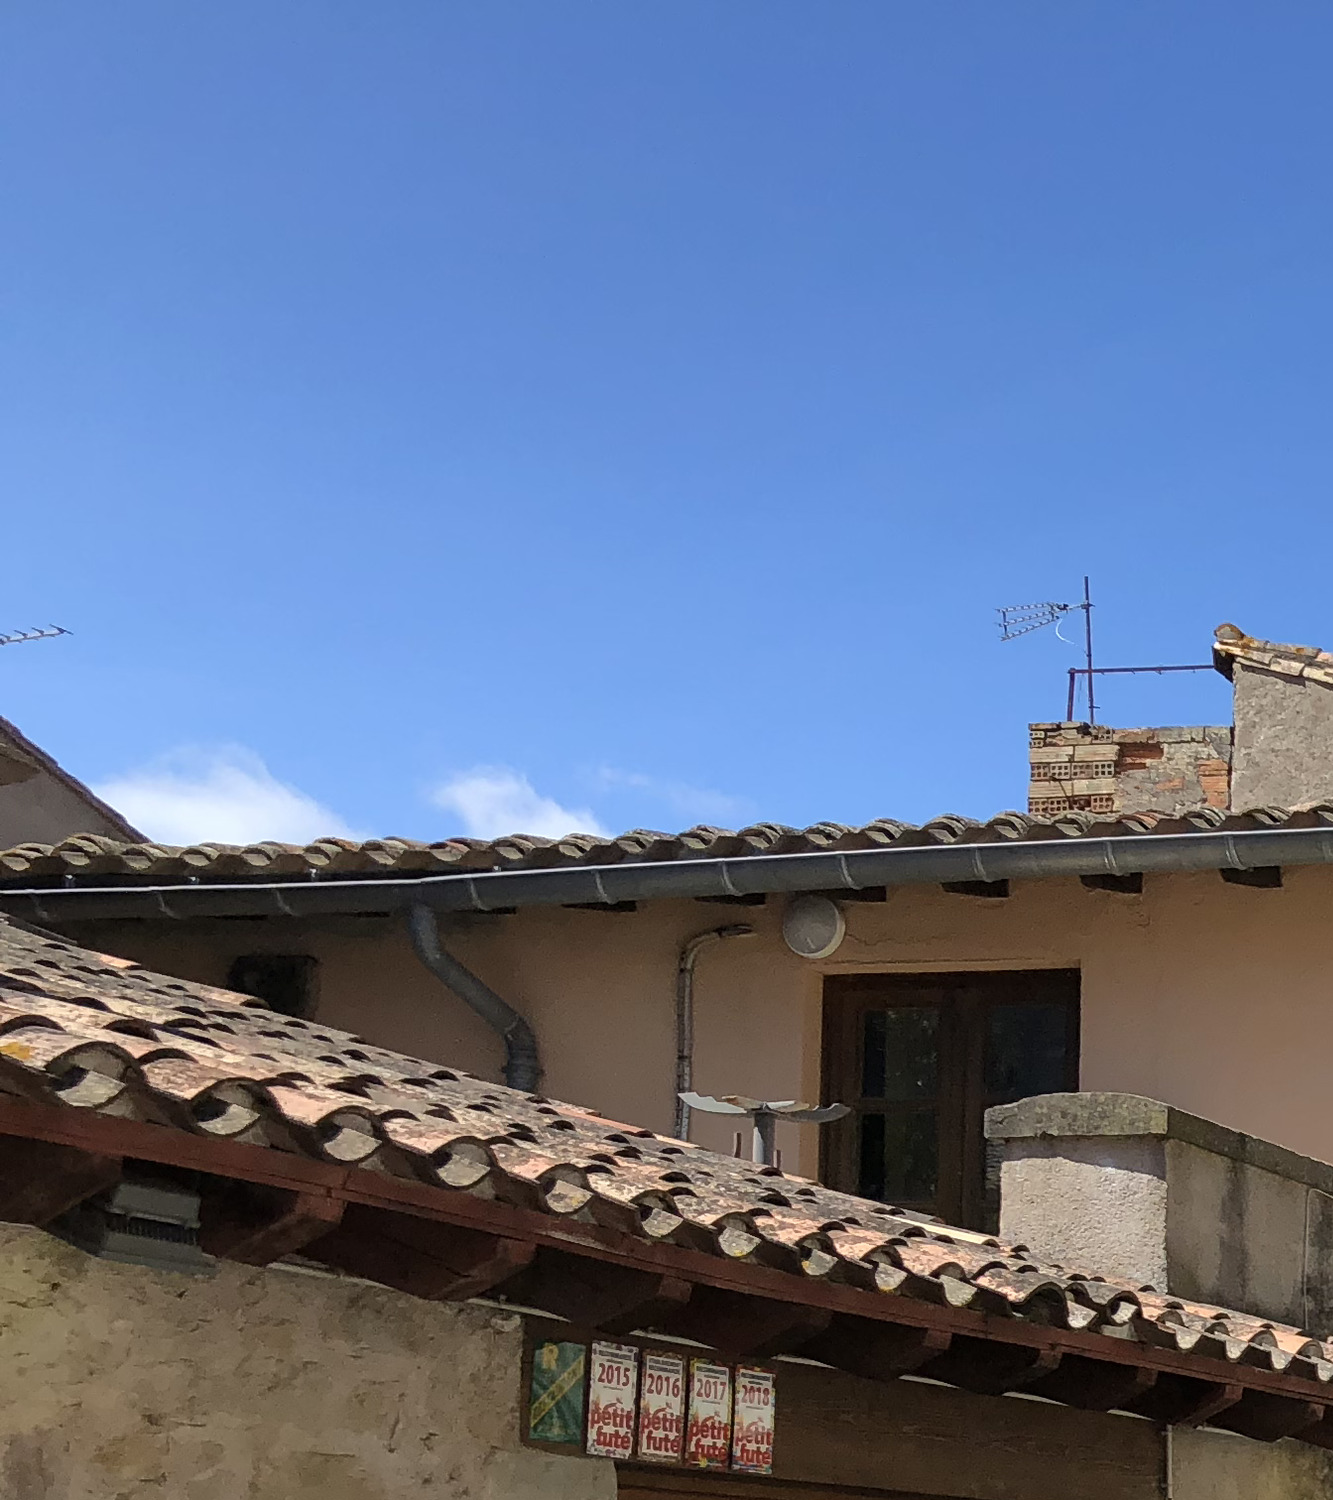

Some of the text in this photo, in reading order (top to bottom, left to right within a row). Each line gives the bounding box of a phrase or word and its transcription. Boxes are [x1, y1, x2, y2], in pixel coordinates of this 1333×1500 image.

[597, 1362, 631, 1387] 2015
[646, 1372, 680, 1398] 2016
[695, 1377, 727, 1401] 2017
[741, 1384, 771, 1407] 2018
[590, 1407, 633, 1429] petit
[640, 1411, 683, 1435] petit
[595, 1425, 631, 1450] futé
[646, 1430, 682, 1454] futé
[688, 1419, 730, 1443] petit
[735, 1424, 773, 1447] petit
[739, 1442, 771, 1466] futé
